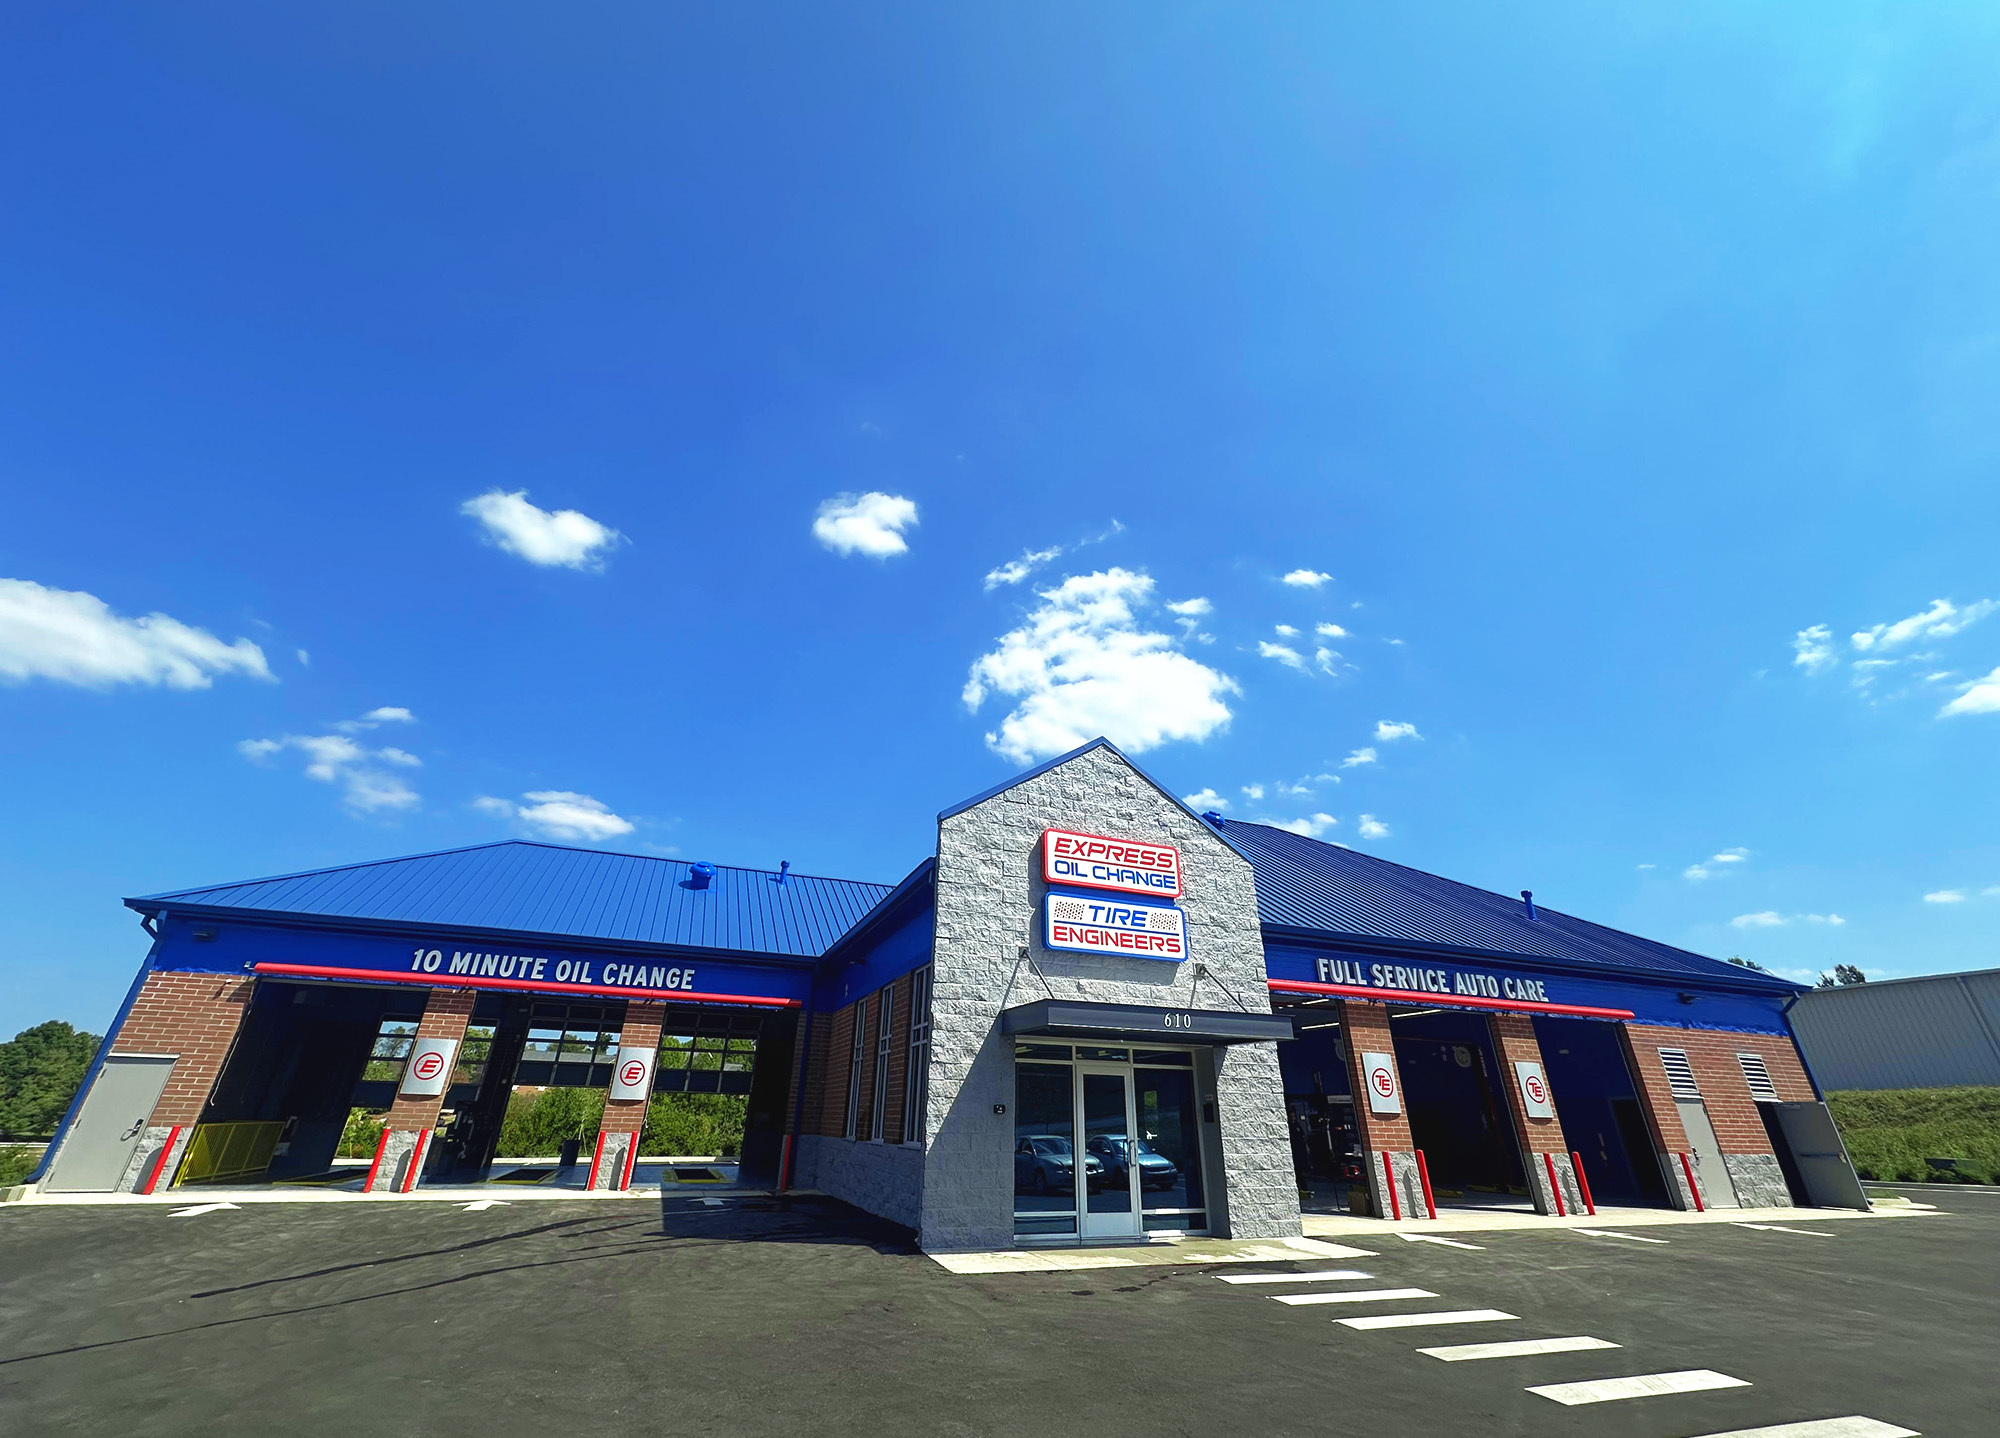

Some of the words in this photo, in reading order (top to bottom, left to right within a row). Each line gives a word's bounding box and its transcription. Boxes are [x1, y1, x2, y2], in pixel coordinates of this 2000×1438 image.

[1054, 837, 1173, 869] EXPRESS
[1054, 860, 1088, 878] OIL
[1092, 865, 1177, 890] CHANGE
[1088, 905, 1148, 928] TIRE
[1053, 925, 1181, 953] ENGINEERS
[411, 948, 442, 973] 10
[448, 951, 548, 980] MINUTE
[555, 959, 592, 984] OIL
[602, 963, 695, 990] CHANGE
[1316, 958, 1367, 985] FULL
[1370, 963, 1451, 993] SERVICE
[1454, 972, 1499, 998] AUTO
[1502, 976, 1549, 1003] CARE
[1164, 1013, 1191, 1029] 610
[419, 1059, 441, 1073] E
[624, 1067, 643, 1080] E
[1375, 1074, 1391, 1092] TE
[1528, 1082, 1543, 1098] TE
